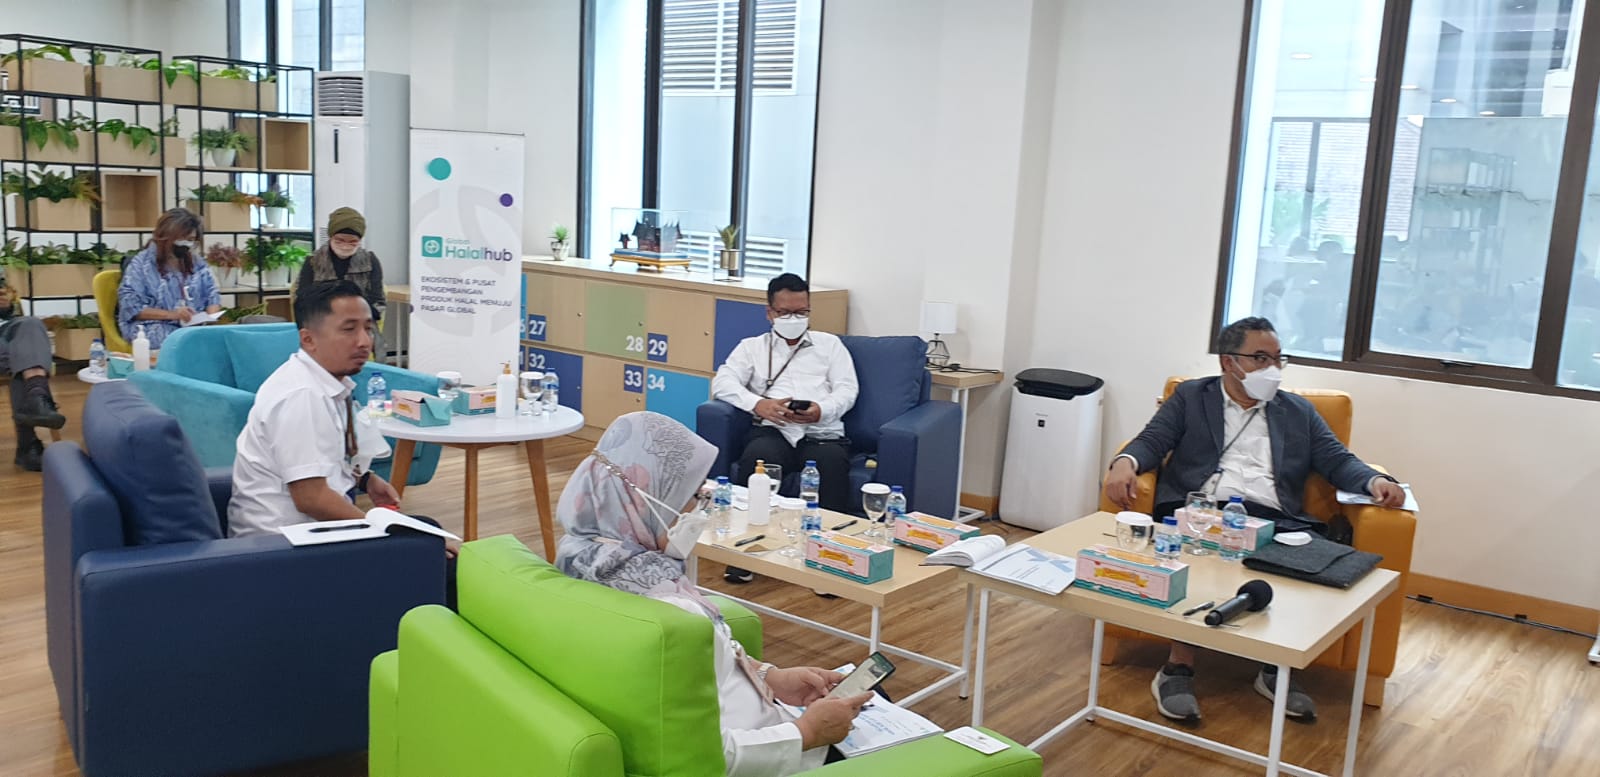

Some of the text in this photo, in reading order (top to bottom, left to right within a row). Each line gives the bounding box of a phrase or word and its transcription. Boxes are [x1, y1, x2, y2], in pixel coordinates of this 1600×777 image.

[445, 246, 513, 261] Halalhub
[421, 276, 464, 284] EKOSISTEM
[421, 286, 484, 295] PENGEMBANGAN
[529, 320, 546, 335] 27
[625, 335, 644, 352] 28
[648, 338, 667, 356] 29
[529, 353, 545, 369] 32
[624, 370, 643, 387] 33
[647, 373, 666, 391] 34
